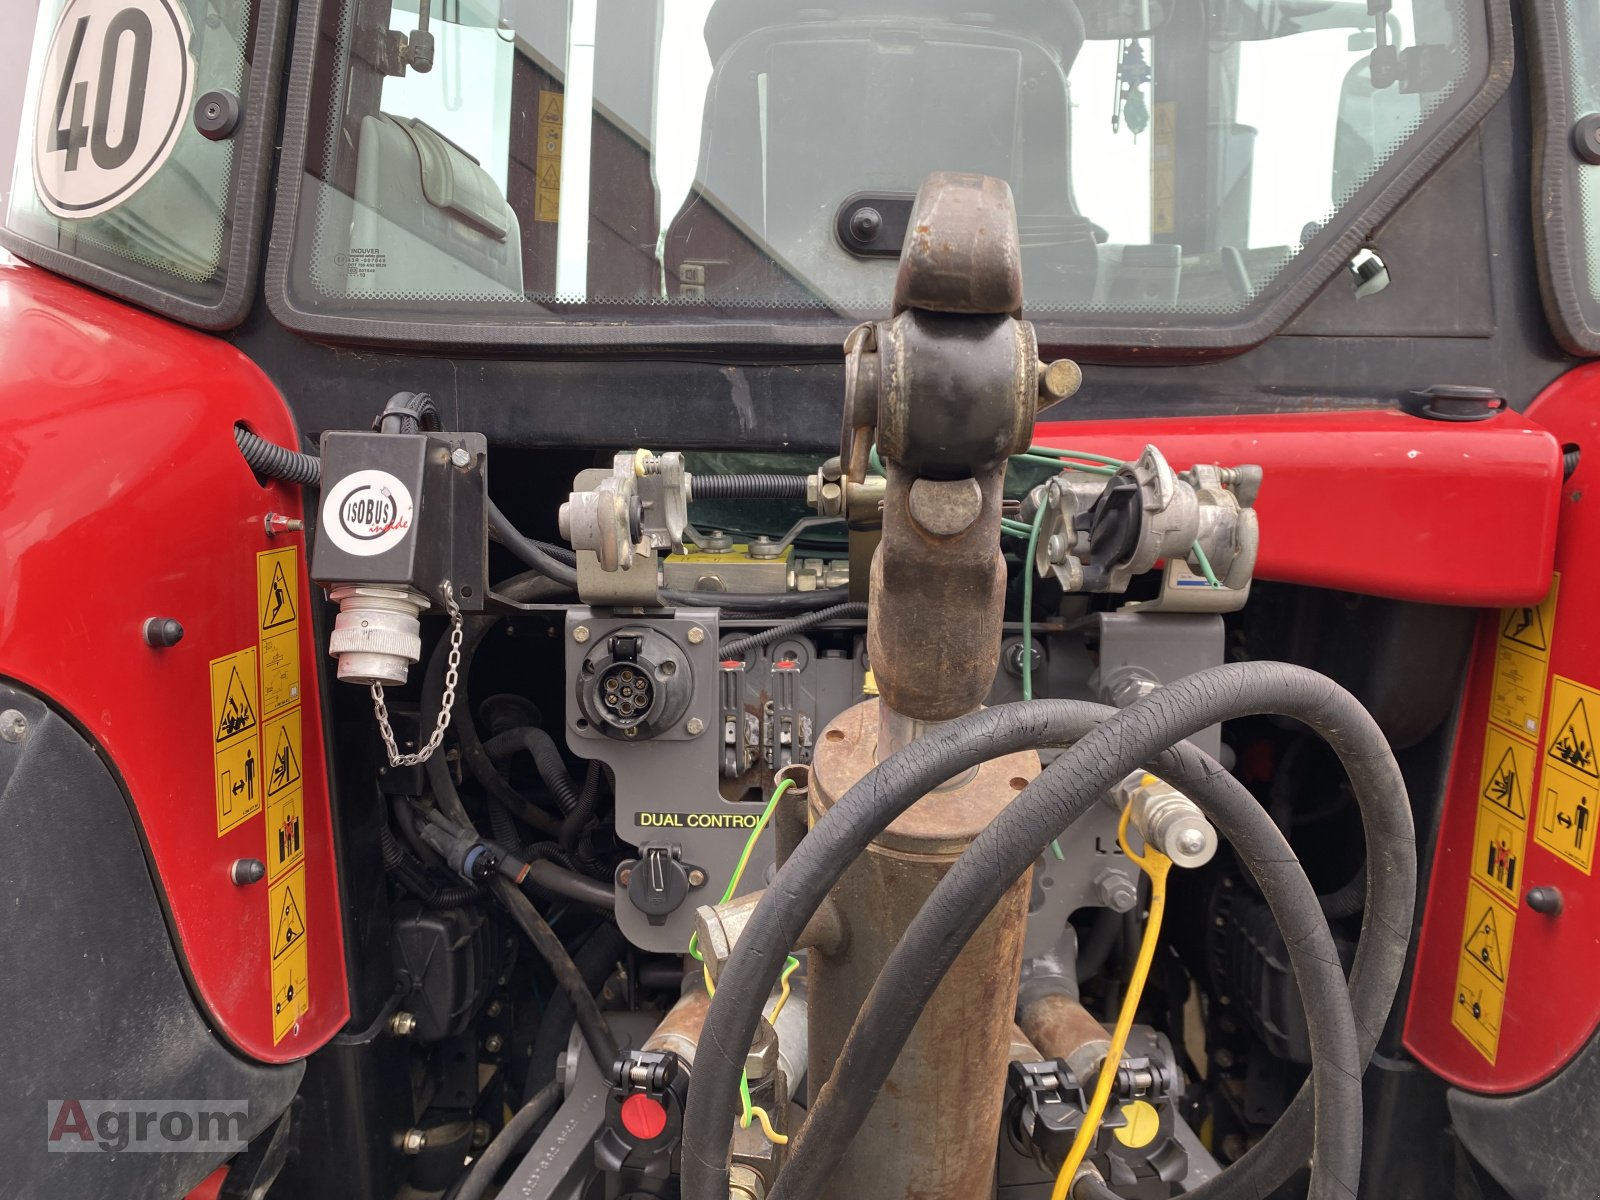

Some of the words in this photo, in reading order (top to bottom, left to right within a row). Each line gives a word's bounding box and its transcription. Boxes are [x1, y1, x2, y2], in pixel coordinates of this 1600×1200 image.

[47, 7, 152, 172] 40
[347, 499, 389, 525] ISOBUS
[640, 813, 683, 827] DUAL
